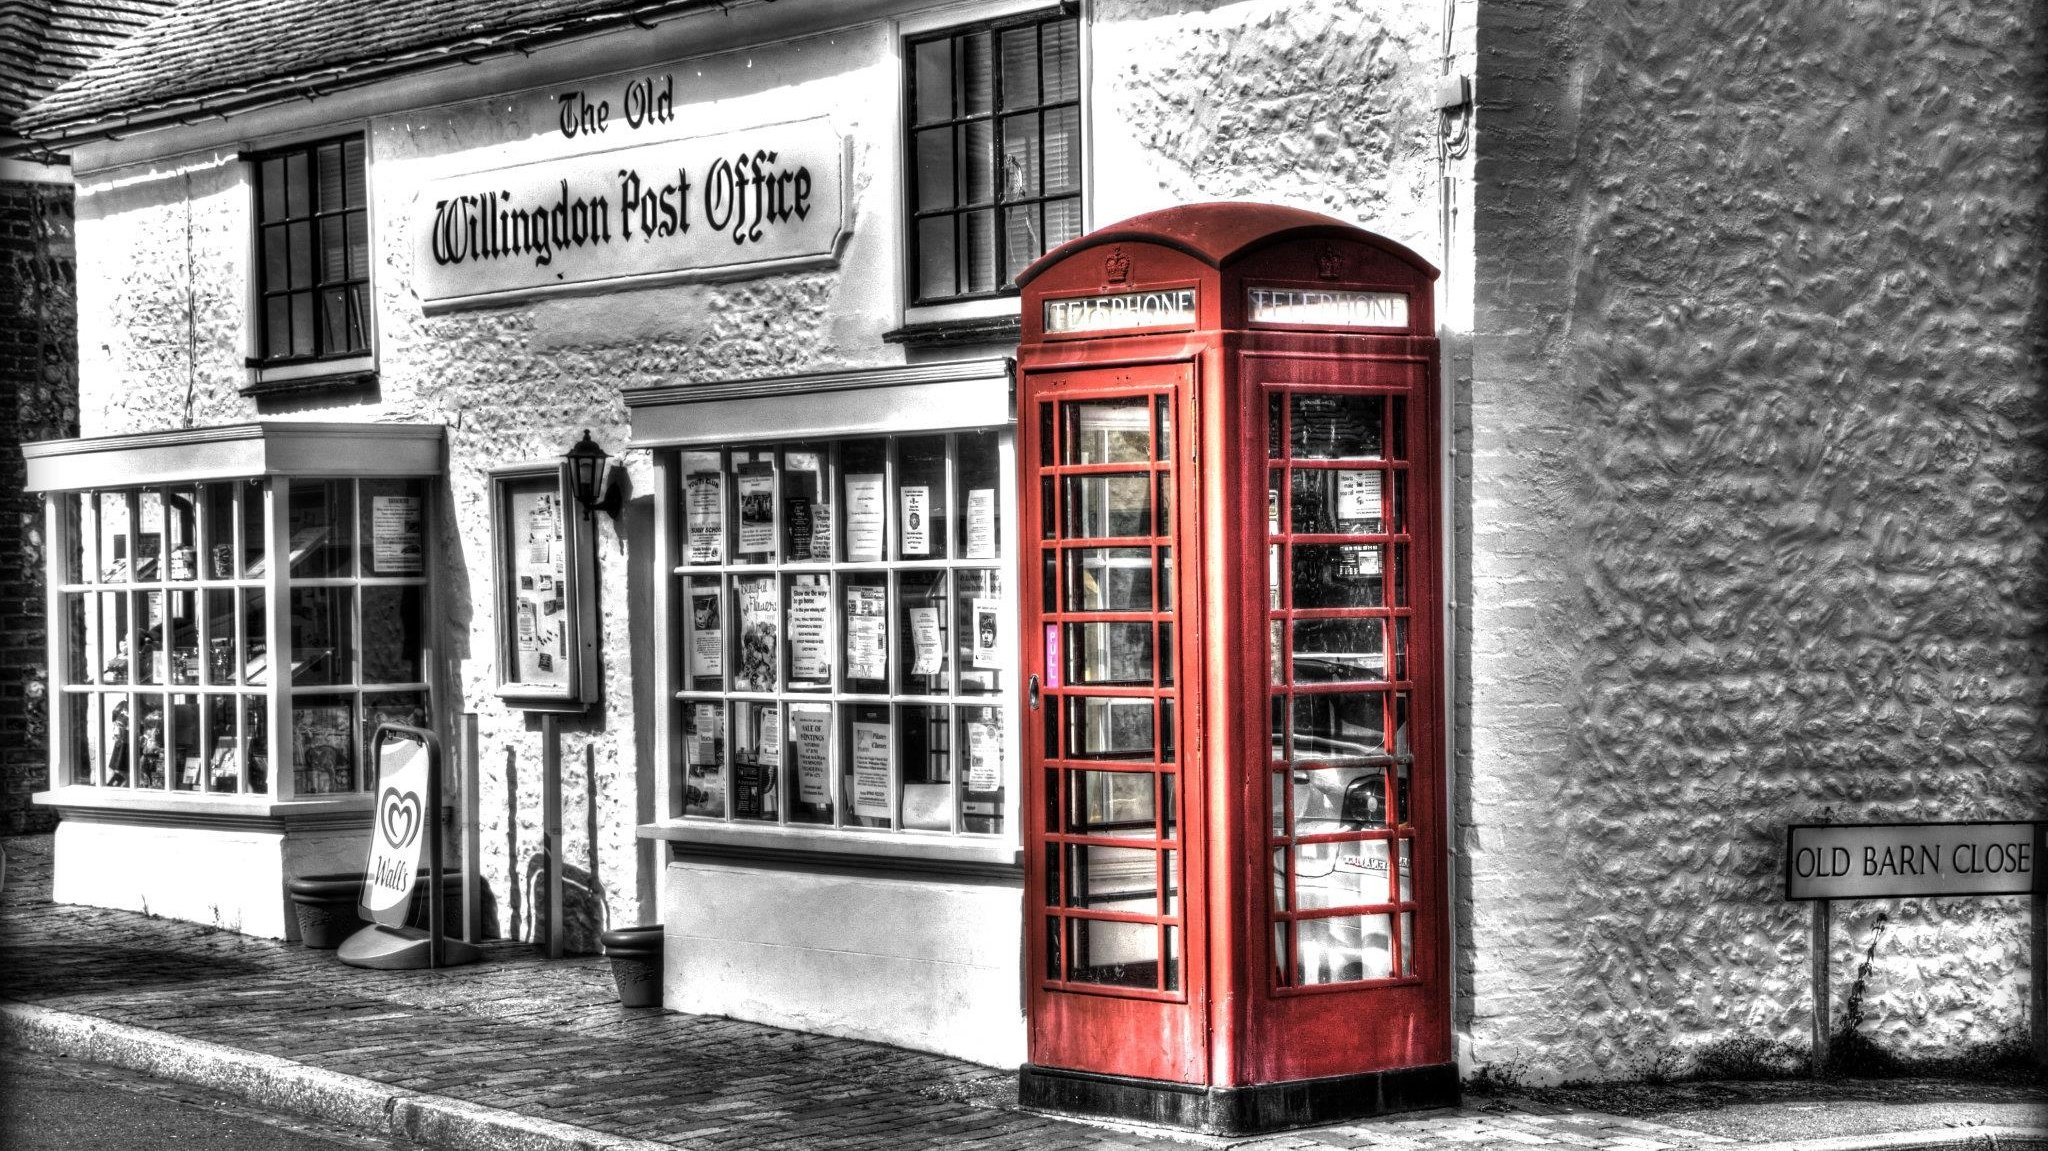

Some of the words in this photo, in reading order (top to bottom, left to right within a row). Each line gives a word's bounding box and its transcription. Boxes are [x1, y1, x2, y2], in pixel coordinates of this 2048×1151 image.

[558, 91, 609, 138] The
[624, 74, 675, 129] Old
[431, 178, 611, 268] Willingdon
[618, 168, 691, 241] Post
[704, 149, 812, 245] Office
[1050, 291, 1191, 328] TELEPHONE
[1253, 291, 1402, 322] TELEPHONE
[1049, 631, 1057, 680] PULL
[374, 855, 408, 892] Wall's
[1796, 847, 1851, 878] OLD
[1863, 844, 1940, 876] BARN
[1953, 843, 2031, 874] CLOSE
